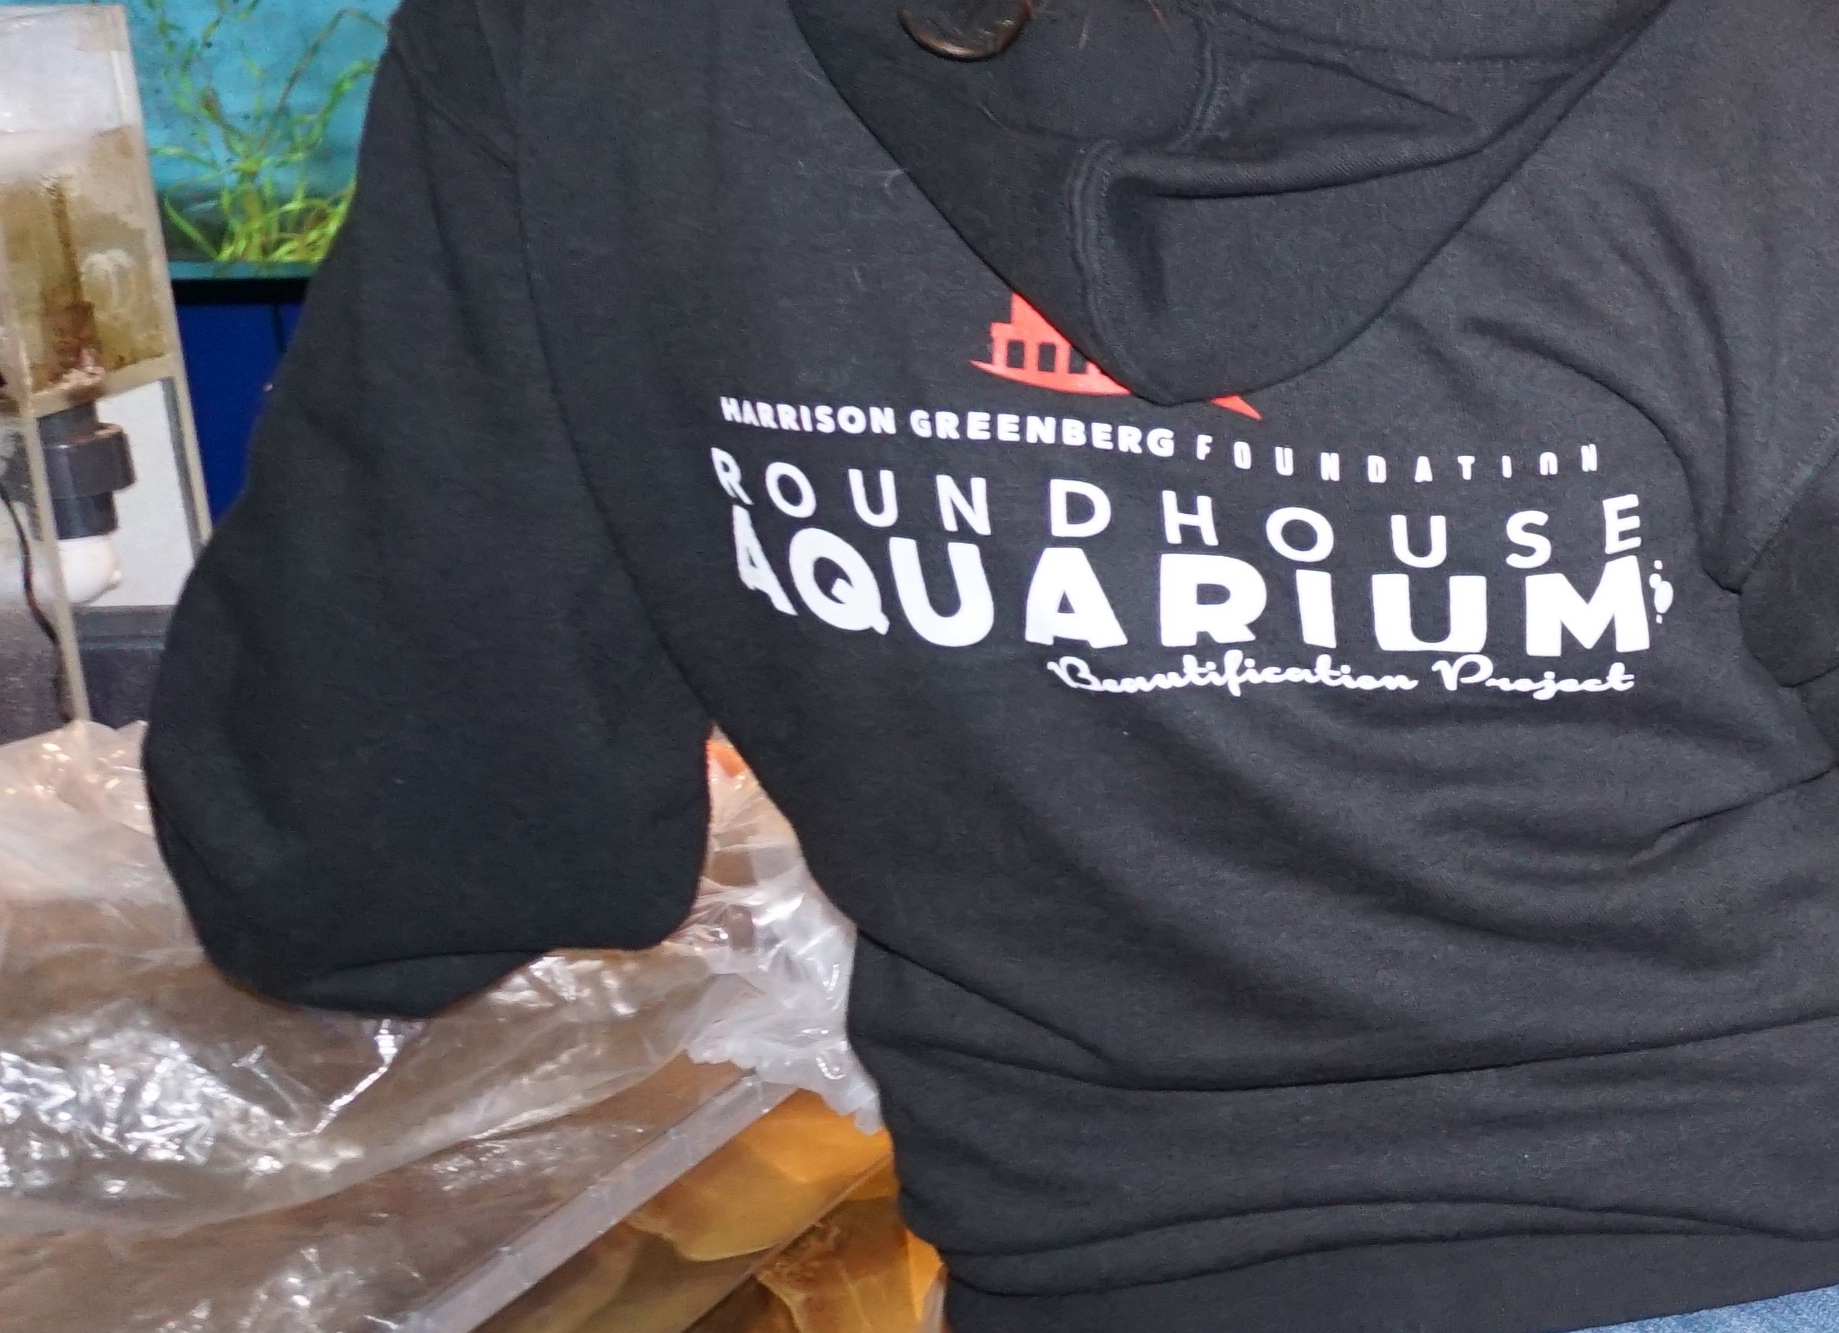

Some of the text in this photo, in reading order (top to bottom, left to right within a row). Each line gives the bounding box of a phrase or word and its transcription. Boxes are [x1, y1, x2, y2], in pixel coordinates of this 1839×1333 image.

[719, 395, 1599, 484] HARRISON GREENBERG FOUNDATION
[710, 446, 1643, 570] ROUNDHOUSE
[731, 504, 1651, 658] AQUARIUM
[1046, 648, 1636, 701] Beautification Project
